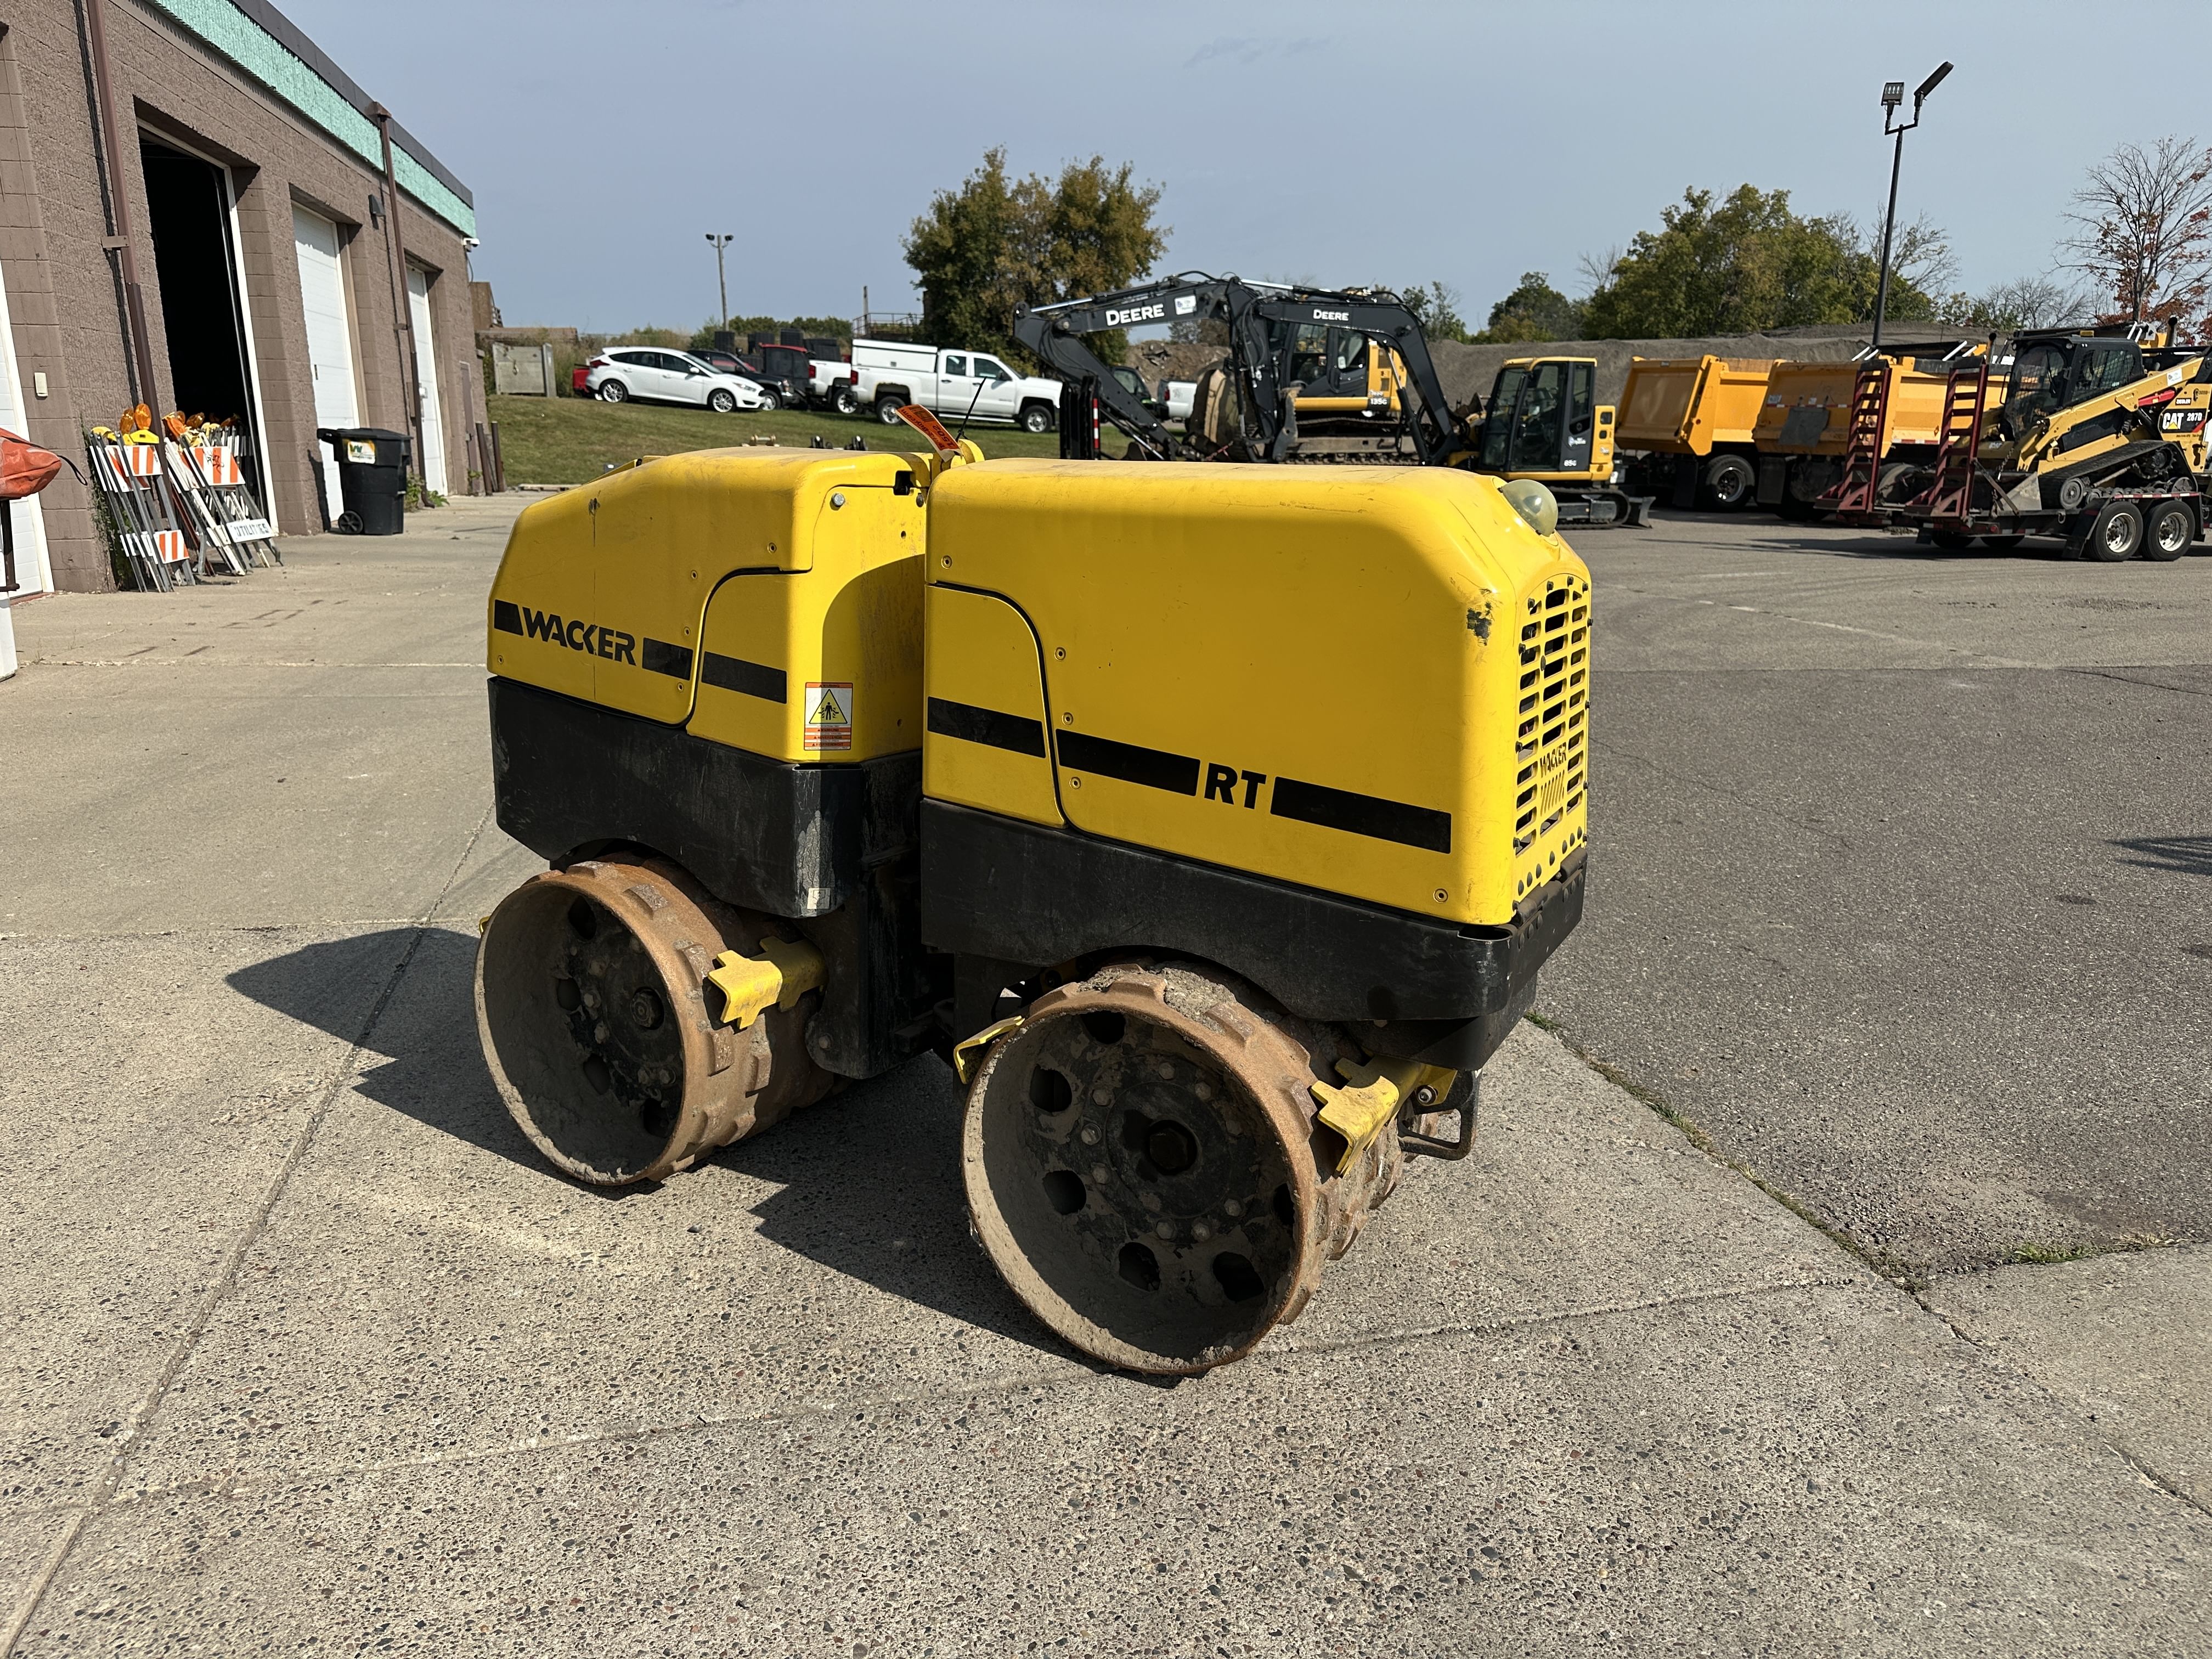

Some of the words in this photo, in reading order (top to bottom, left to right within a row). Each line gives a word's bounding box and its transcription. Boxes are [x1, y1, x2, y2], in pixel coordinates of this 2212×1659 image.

[1105, 303, 1165, 326] DEERE
[1313, 309, 1349, 321] DEERE
[2162, 413, 2184, 430] CAT
[933, 425, 955, 447] 1502
[522, 606, 636, 666] WACKER
[1539, 742, 1567, 778] WACKER
[1204, 762, 1267, 810] RT
